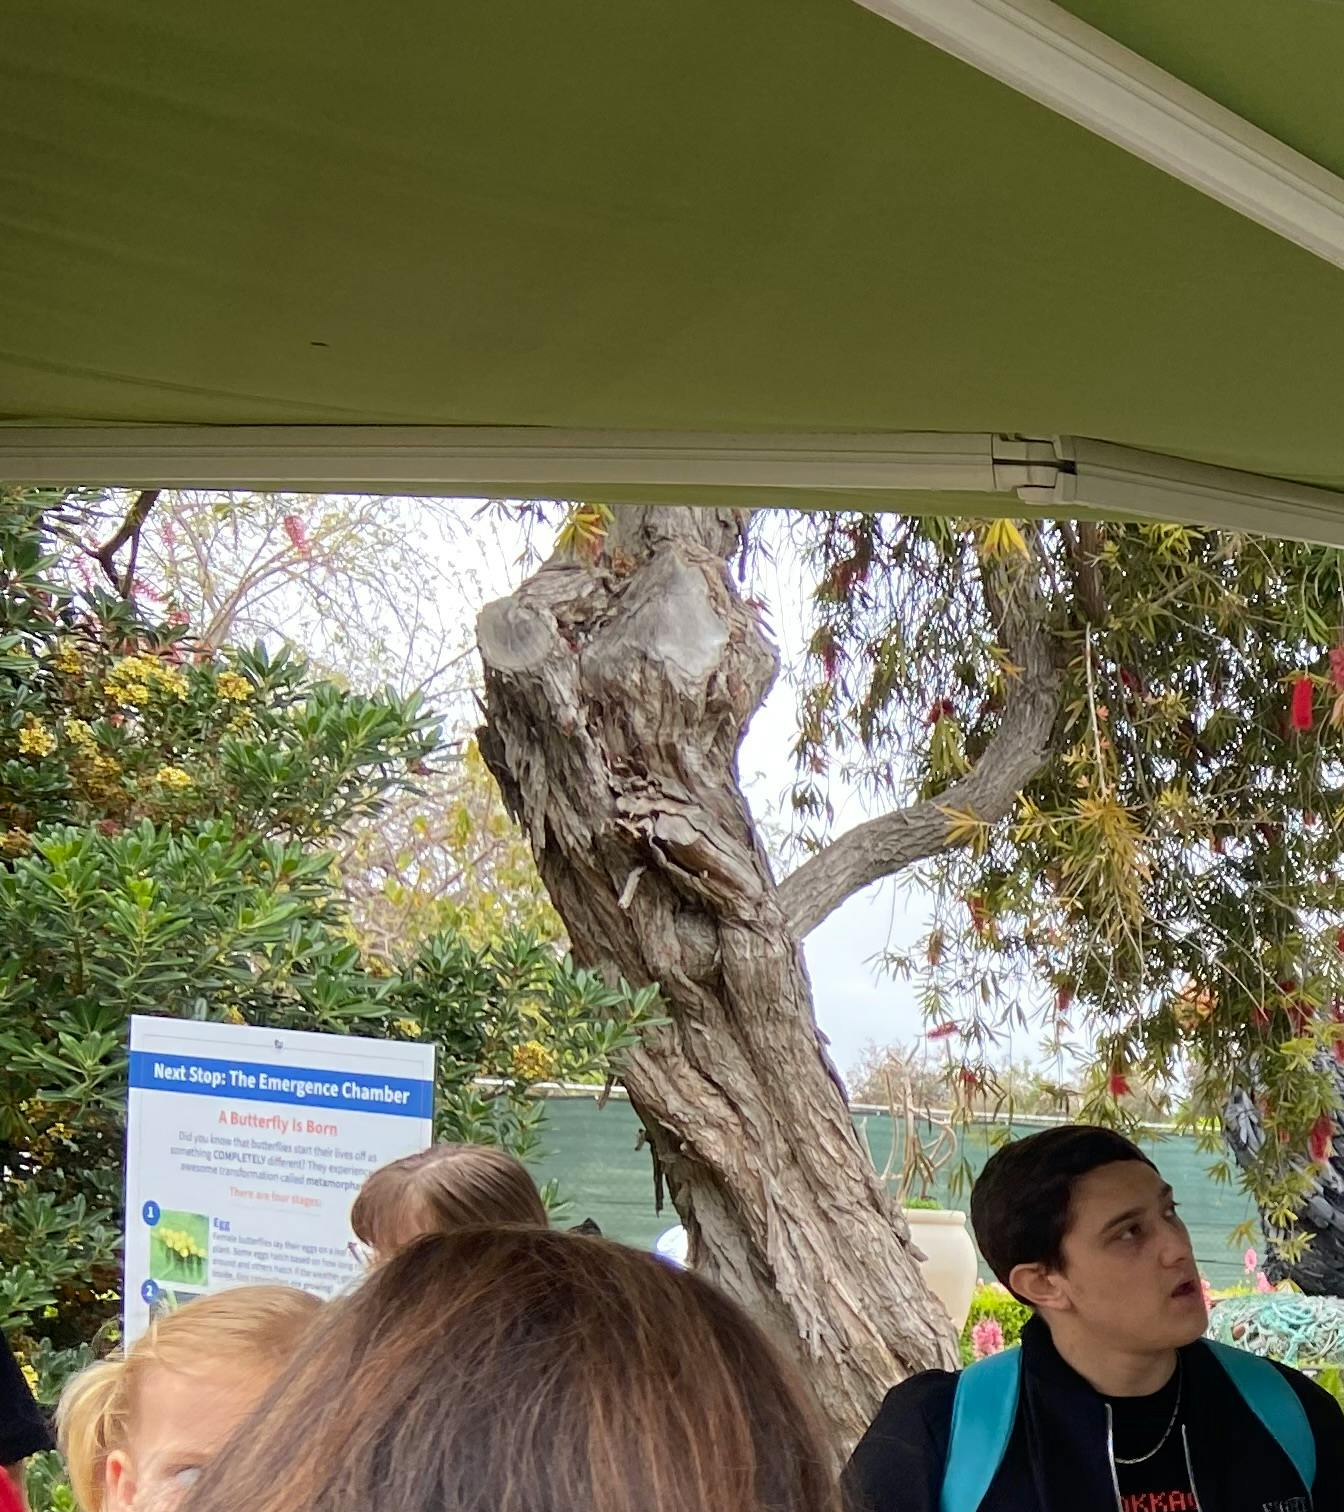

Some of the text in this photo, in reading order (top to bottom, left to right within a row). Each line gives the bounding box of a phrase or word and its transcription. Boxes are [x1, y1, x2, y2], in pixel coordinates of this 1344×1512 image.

[154, 1063, 410, 1105] Next Stop: The Emergence Chamber
[219, 1111, 227, 1124] A
[231, 1112, 289, 1134] Butterfly
[307, 1120, 338, 1136] Born
[179, 1131, 377, 1162] Did you know that butterflies start their lives off as
[148, 1206, 153, 1218] 1
[214, 1218, 230, 1232] Egg
[147, 1287, 153, 1297] 2
